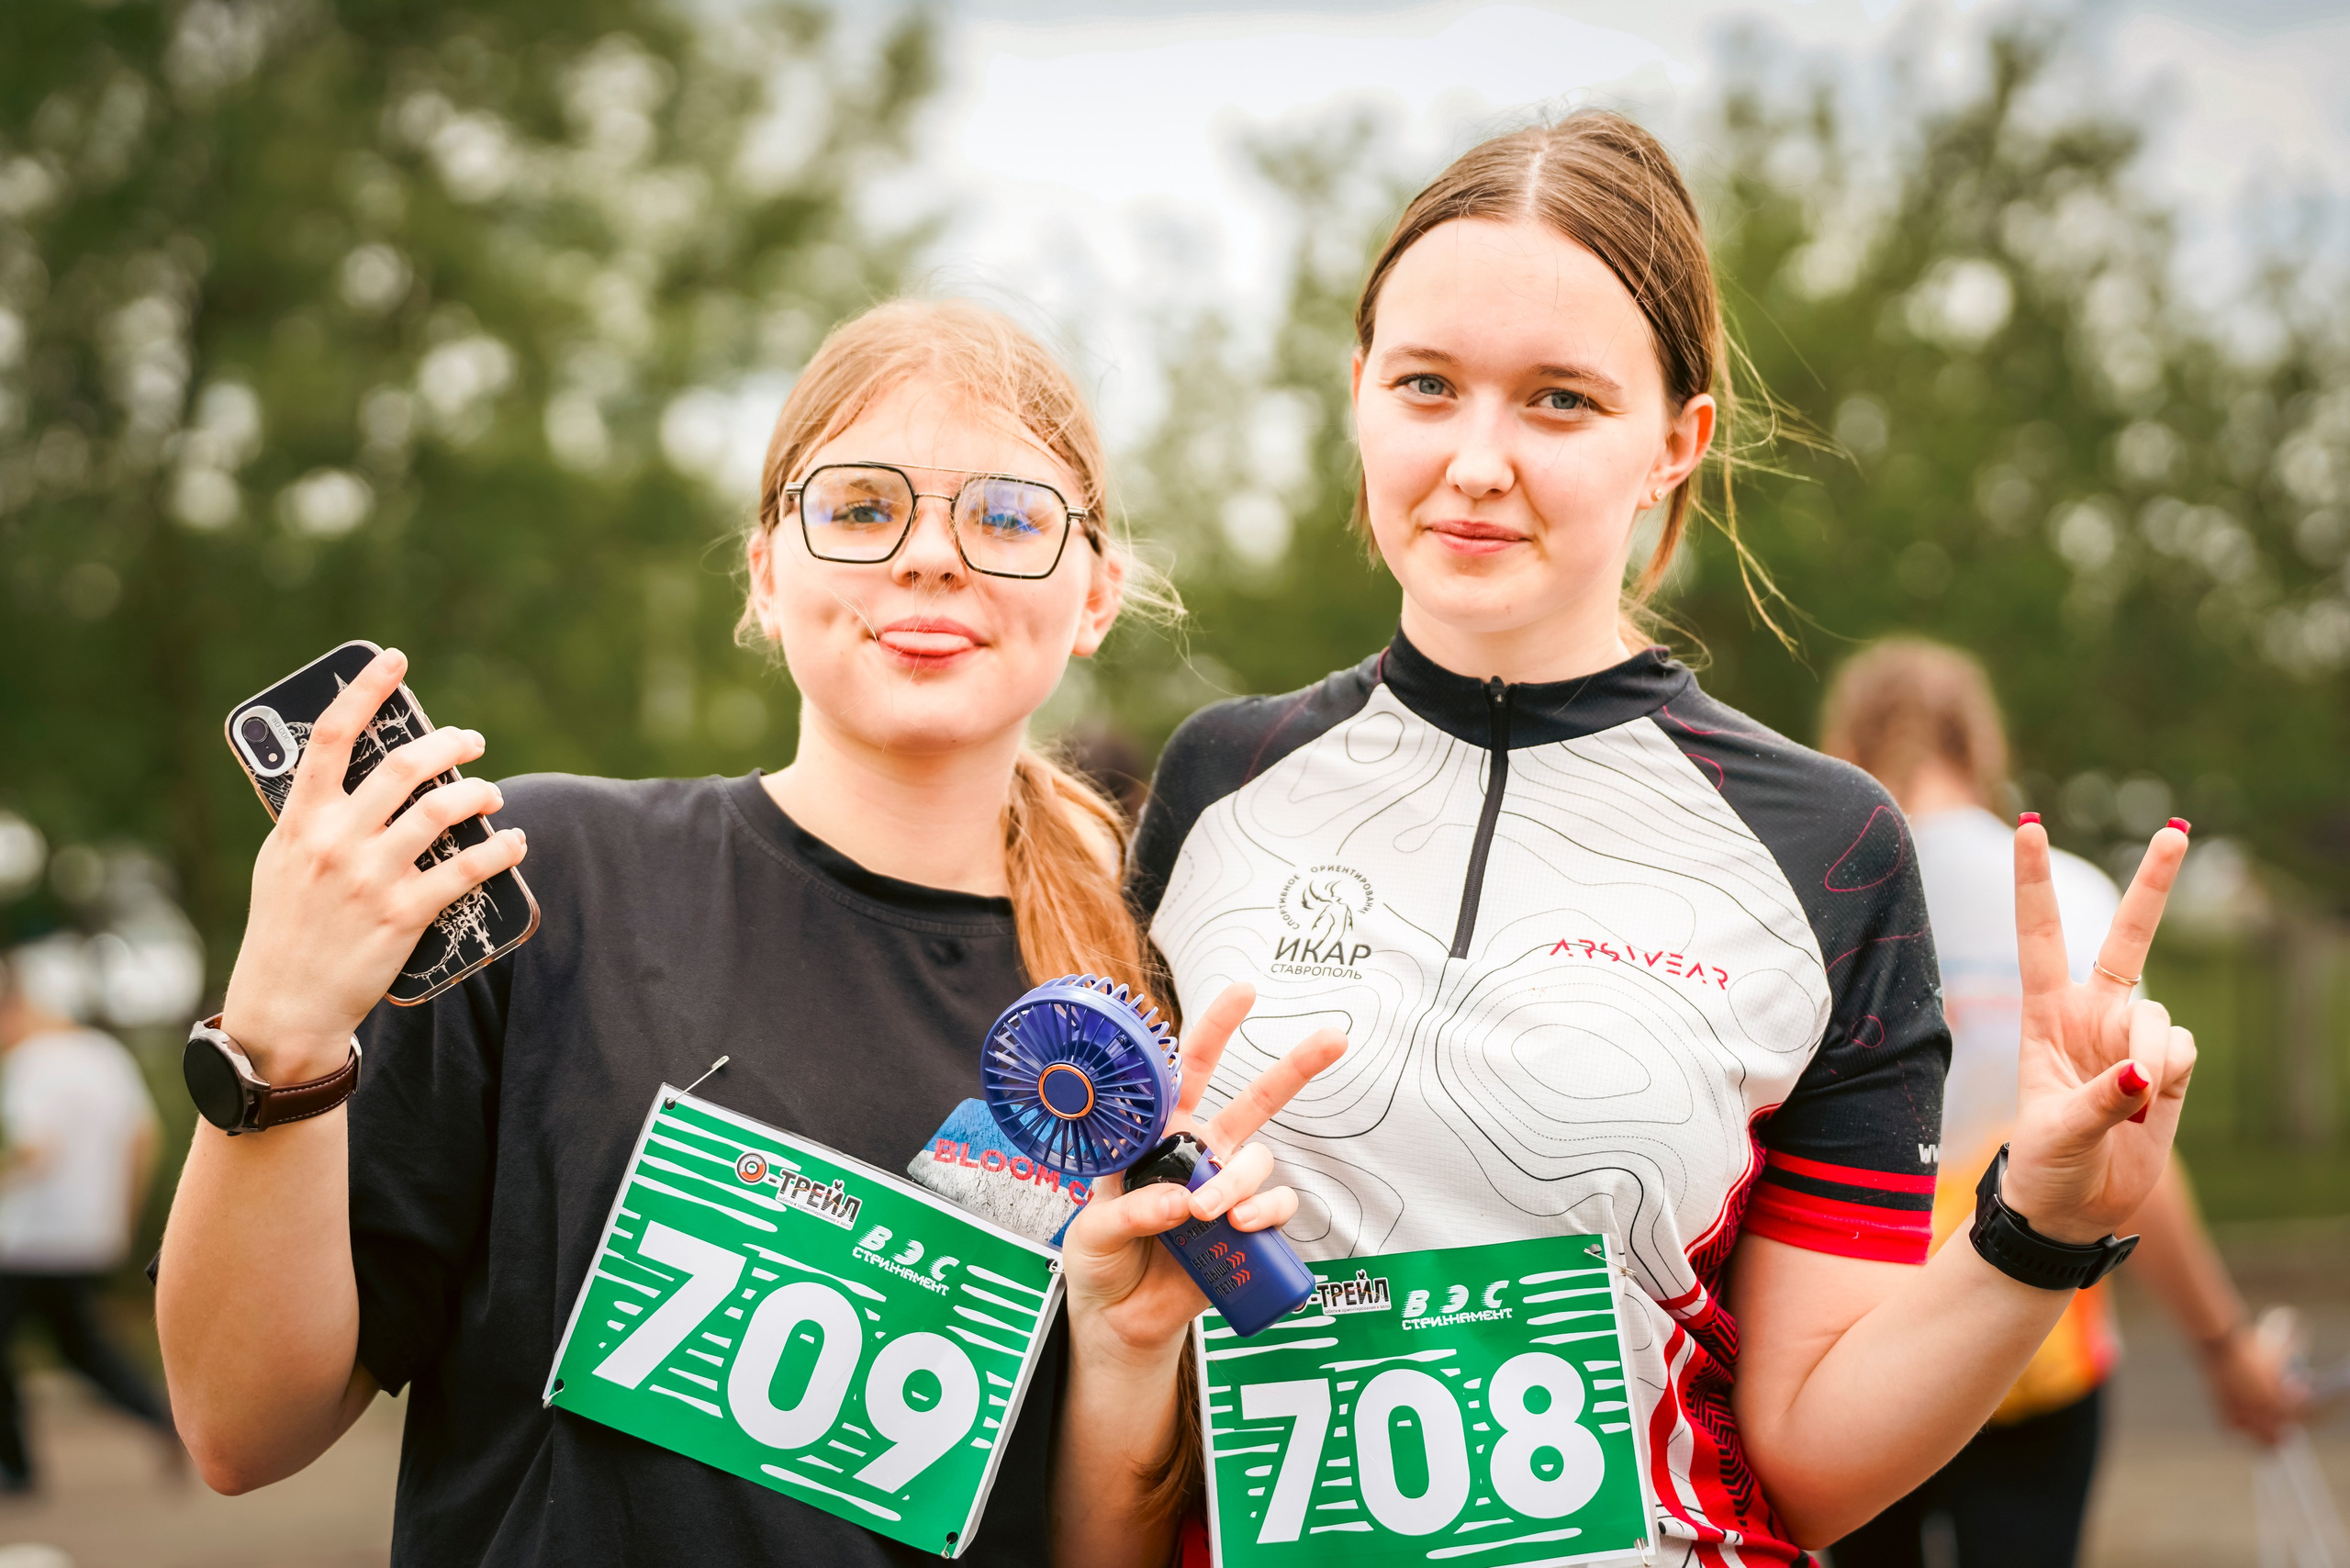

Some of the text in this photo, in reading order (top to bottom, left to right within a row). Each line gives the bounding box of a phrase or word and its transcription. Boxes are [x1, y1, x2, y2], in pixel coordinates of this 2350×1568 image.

[1279, 865, 1374, 930] СПОРТИВНОЕ ОРИЕНТИРОВАНИЕ
[1274, 936, 1371, 966] ИКАР
[1270, 963, 1362, 980] СТАВРОПОЛЬ
[934, 1138, 1094, 1205] BLOOM C
[852, 1246, 950, 1296] СТРИЖАМЕНТ
[1191, 1249, 1215, 1271] БЕГИ
[1203, 1260, 1234, 1286] ДЫШИ
[1214, 1277, 1239, 1298] ЛЕТИ
[1293, 1271, 1390, 1313] -ТРЕЙЛ
[1402, 1307, 1513, 1330] СТРИЖАМЕНТ
[591, 1220, 980, 1494] 709
[1239, 1351, 1606, 1544] 708
